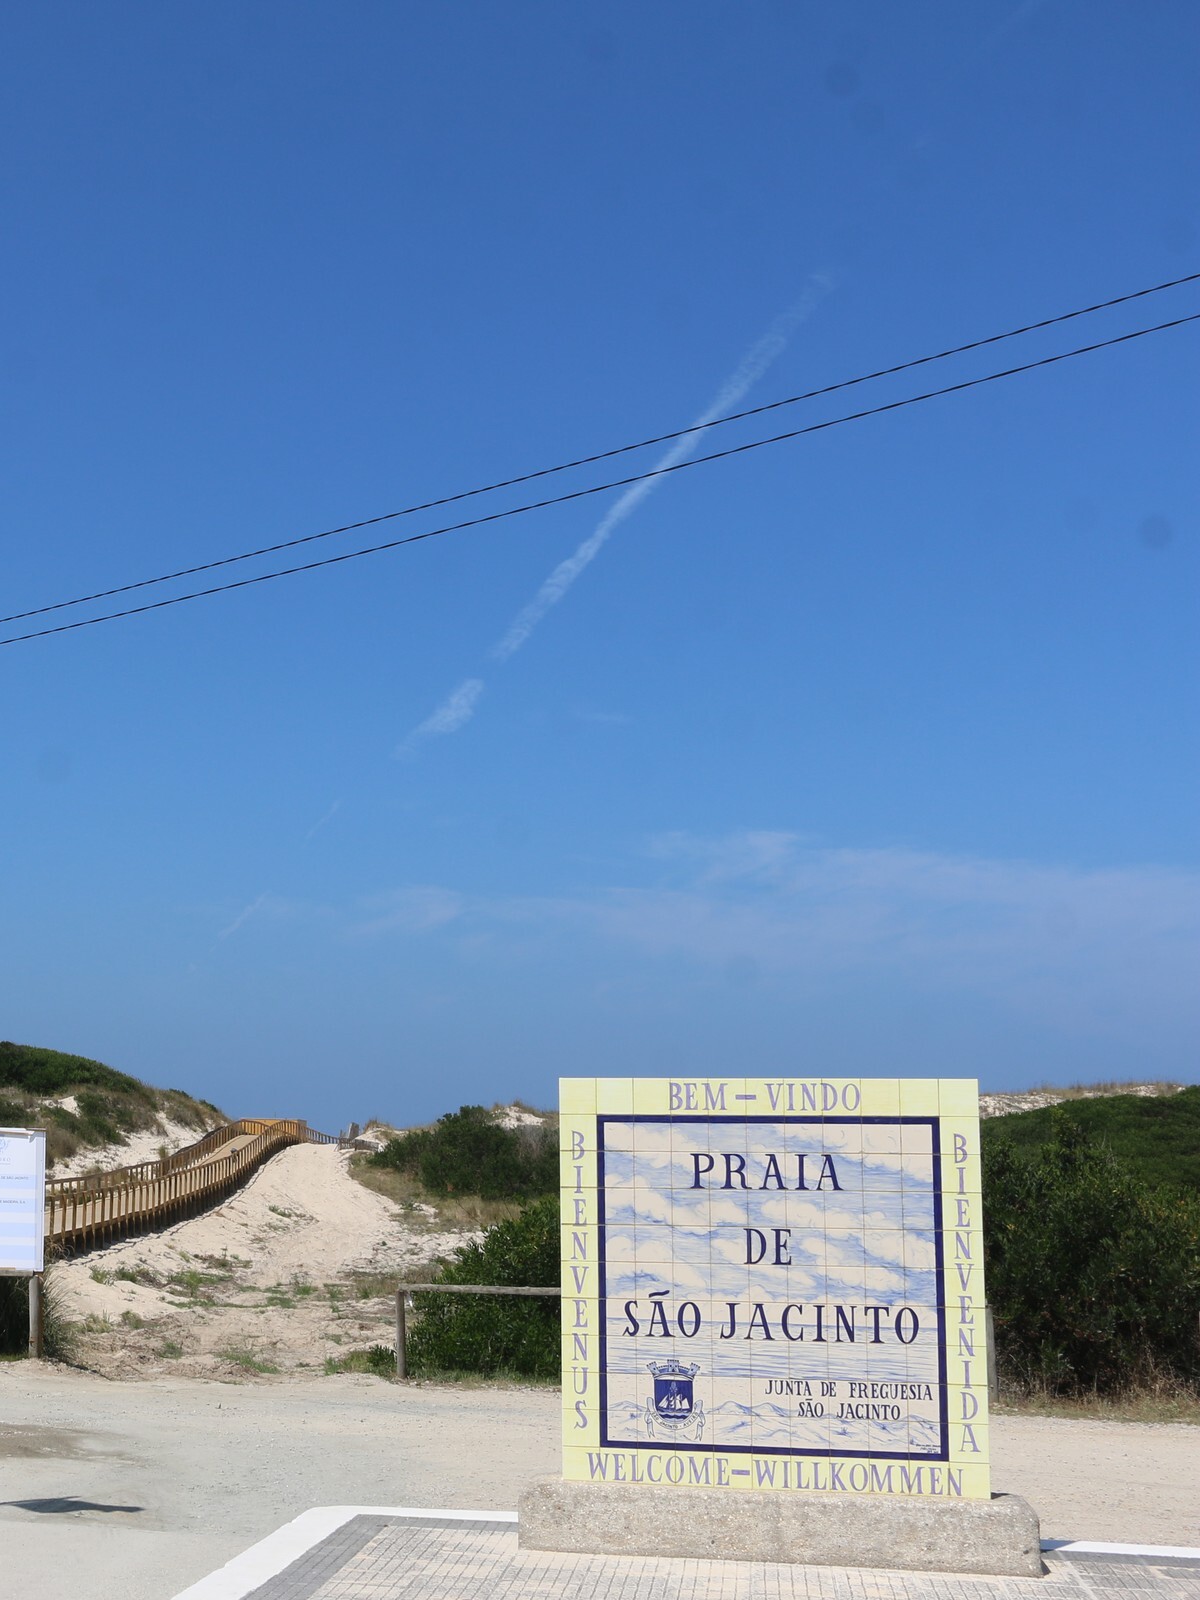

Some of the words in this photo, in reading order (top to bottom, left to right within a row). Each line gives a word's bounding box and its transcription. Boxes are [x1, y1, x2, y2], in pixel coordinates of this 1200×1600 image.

[690, 1152, 845, 1192] PRAIA
[743, 1228, 793, 1266] DE
[570, 1130, 590, 1430] BIENVENUS
[952, 1132, 982, 1454] BIENVENIDA
[622, 1289, 702, 1339] SÃO
[719, 1302, 920, 1345] JACINTO
[765, 1380, 812, 1396] JUNTA
[821, 1381, 837, 1397] DE
[848, 1382, 933, 1401] FREGUESIA
[797, 1398, 825, 1418] SÃO
[836, 1402, 901, 1421] JACINTO
